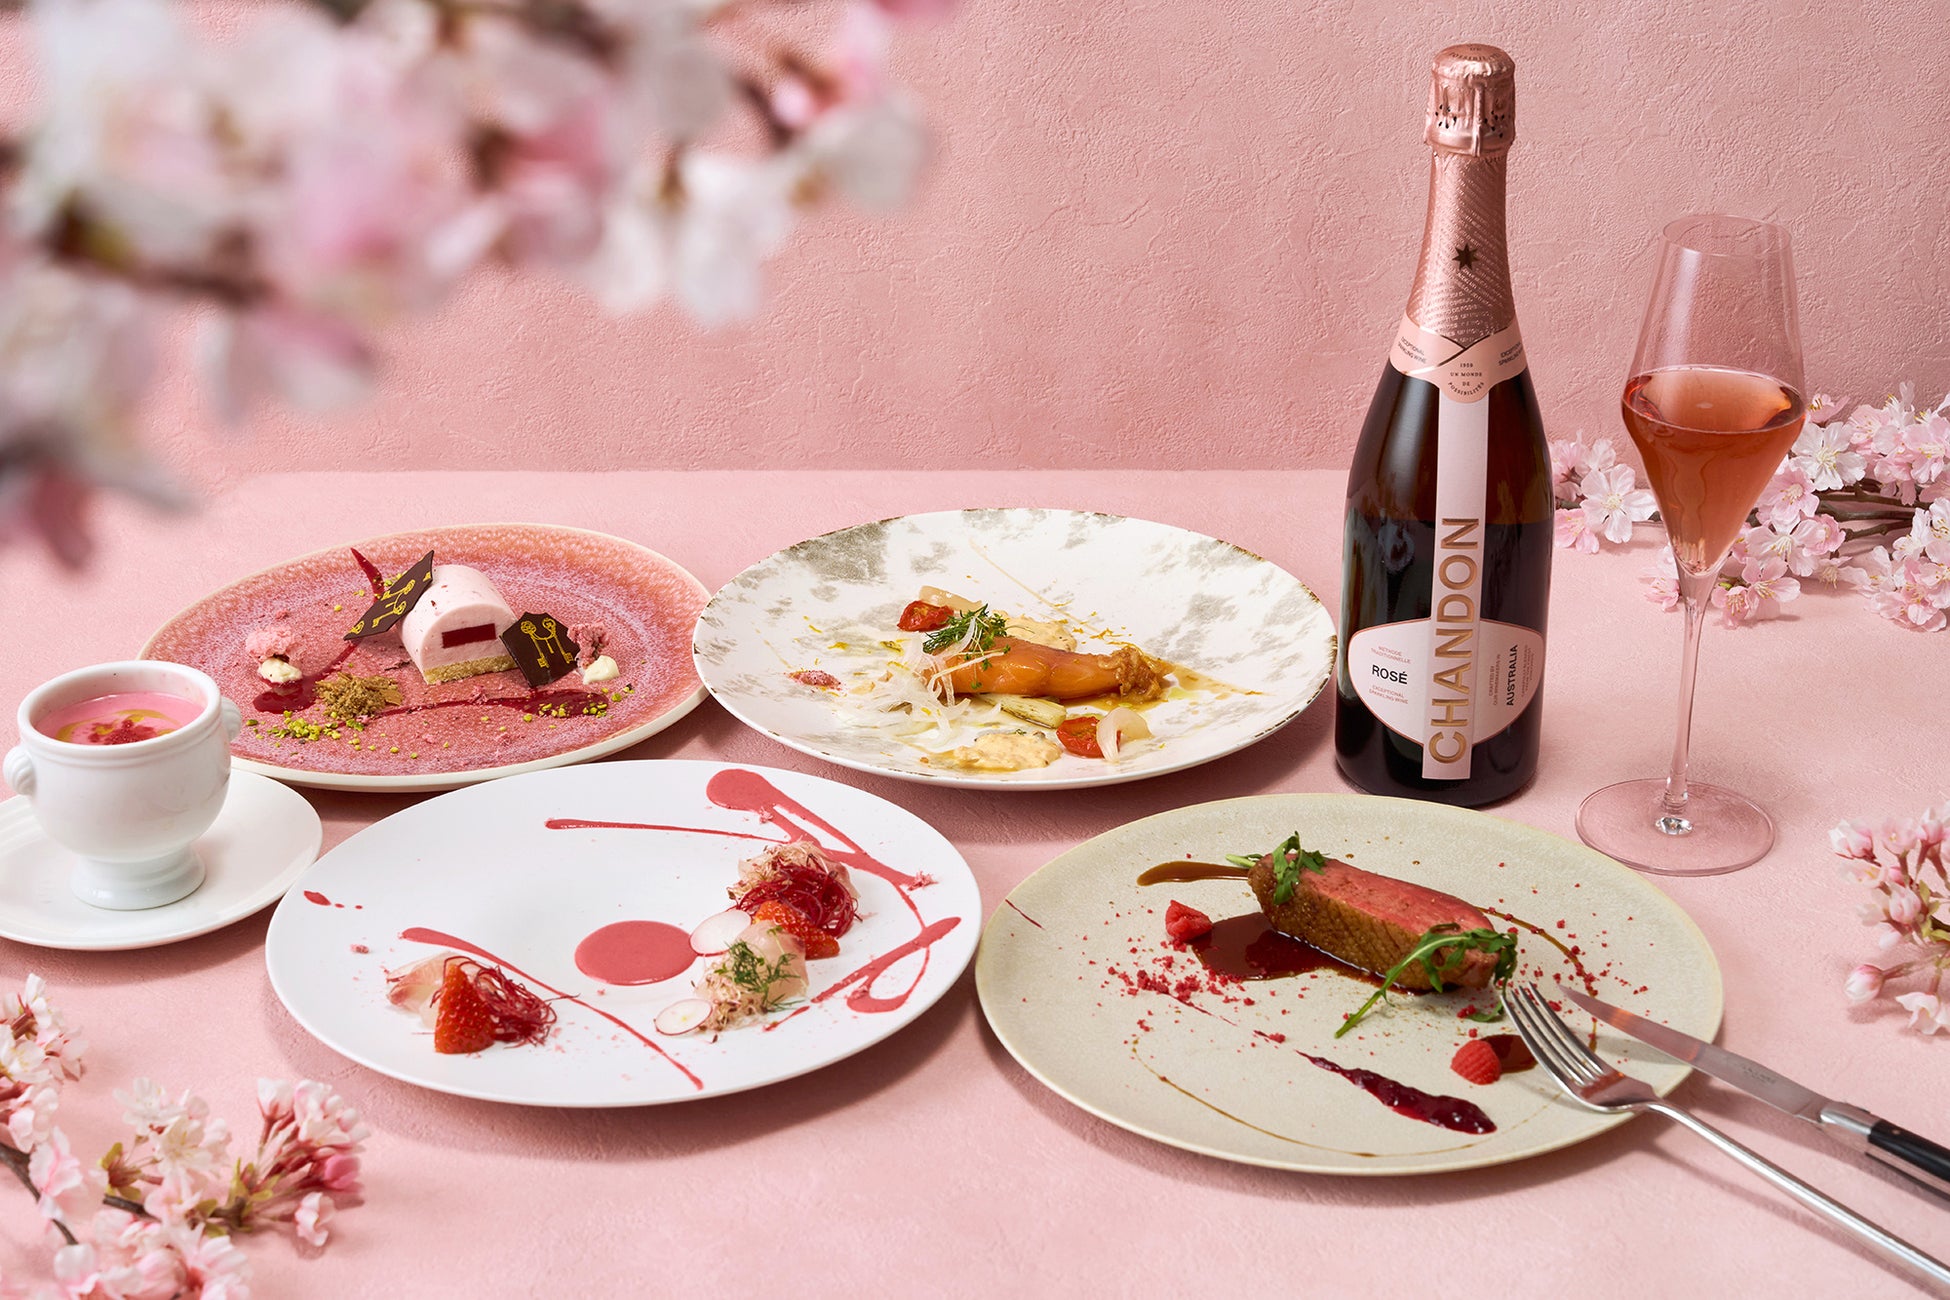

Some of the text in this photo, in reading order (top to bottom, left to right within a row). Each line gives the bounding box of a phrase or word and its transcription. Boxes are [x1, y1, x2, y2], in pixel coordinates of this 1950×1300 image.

[1428, 518, 1479, 764] CHANDON
[1371, 664, 1408, 685] ROSÉ
[1372, 684, 1405, 698] EXCEPTIONAL
[1506, 644, 1518, 706] AUSTRALIA
